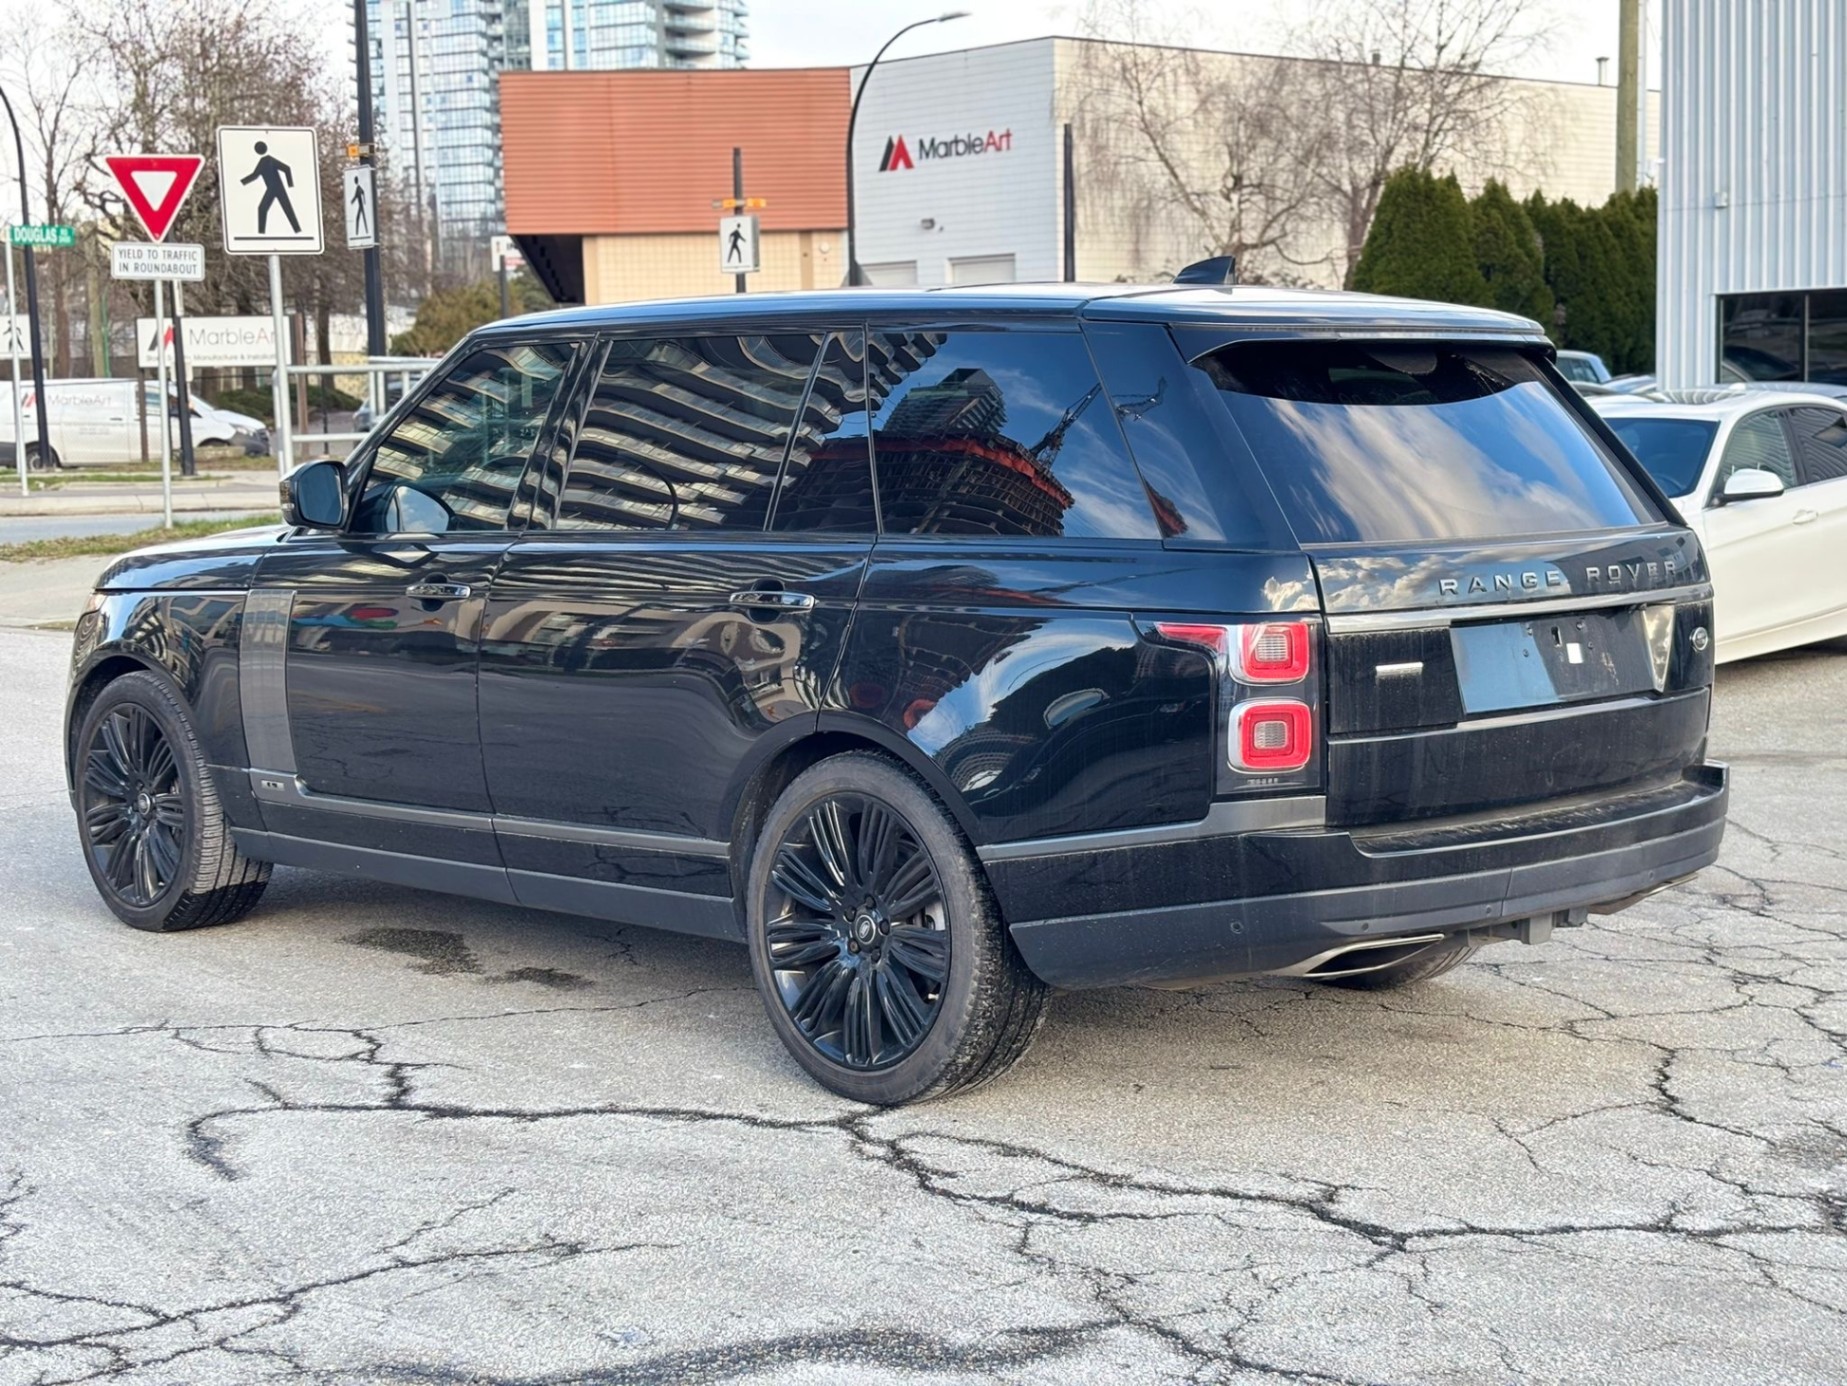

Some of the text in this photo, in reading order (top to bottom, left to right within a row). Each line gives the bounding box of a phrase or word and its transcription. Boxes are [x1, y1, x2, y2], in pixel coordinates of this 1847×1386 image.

[918, 128, 1012, 160] MarbleArt
[13, 226, 57, 244] DOUGLAS
[118, 248, 198, 261] YIELD TO TRAFFIC
[118, 263, 198, 275] IN ROUNDABOUT
[188, 327, 276, 346] MarbleAr
[1438, 560, 1676, 596] RANGE ROVER
